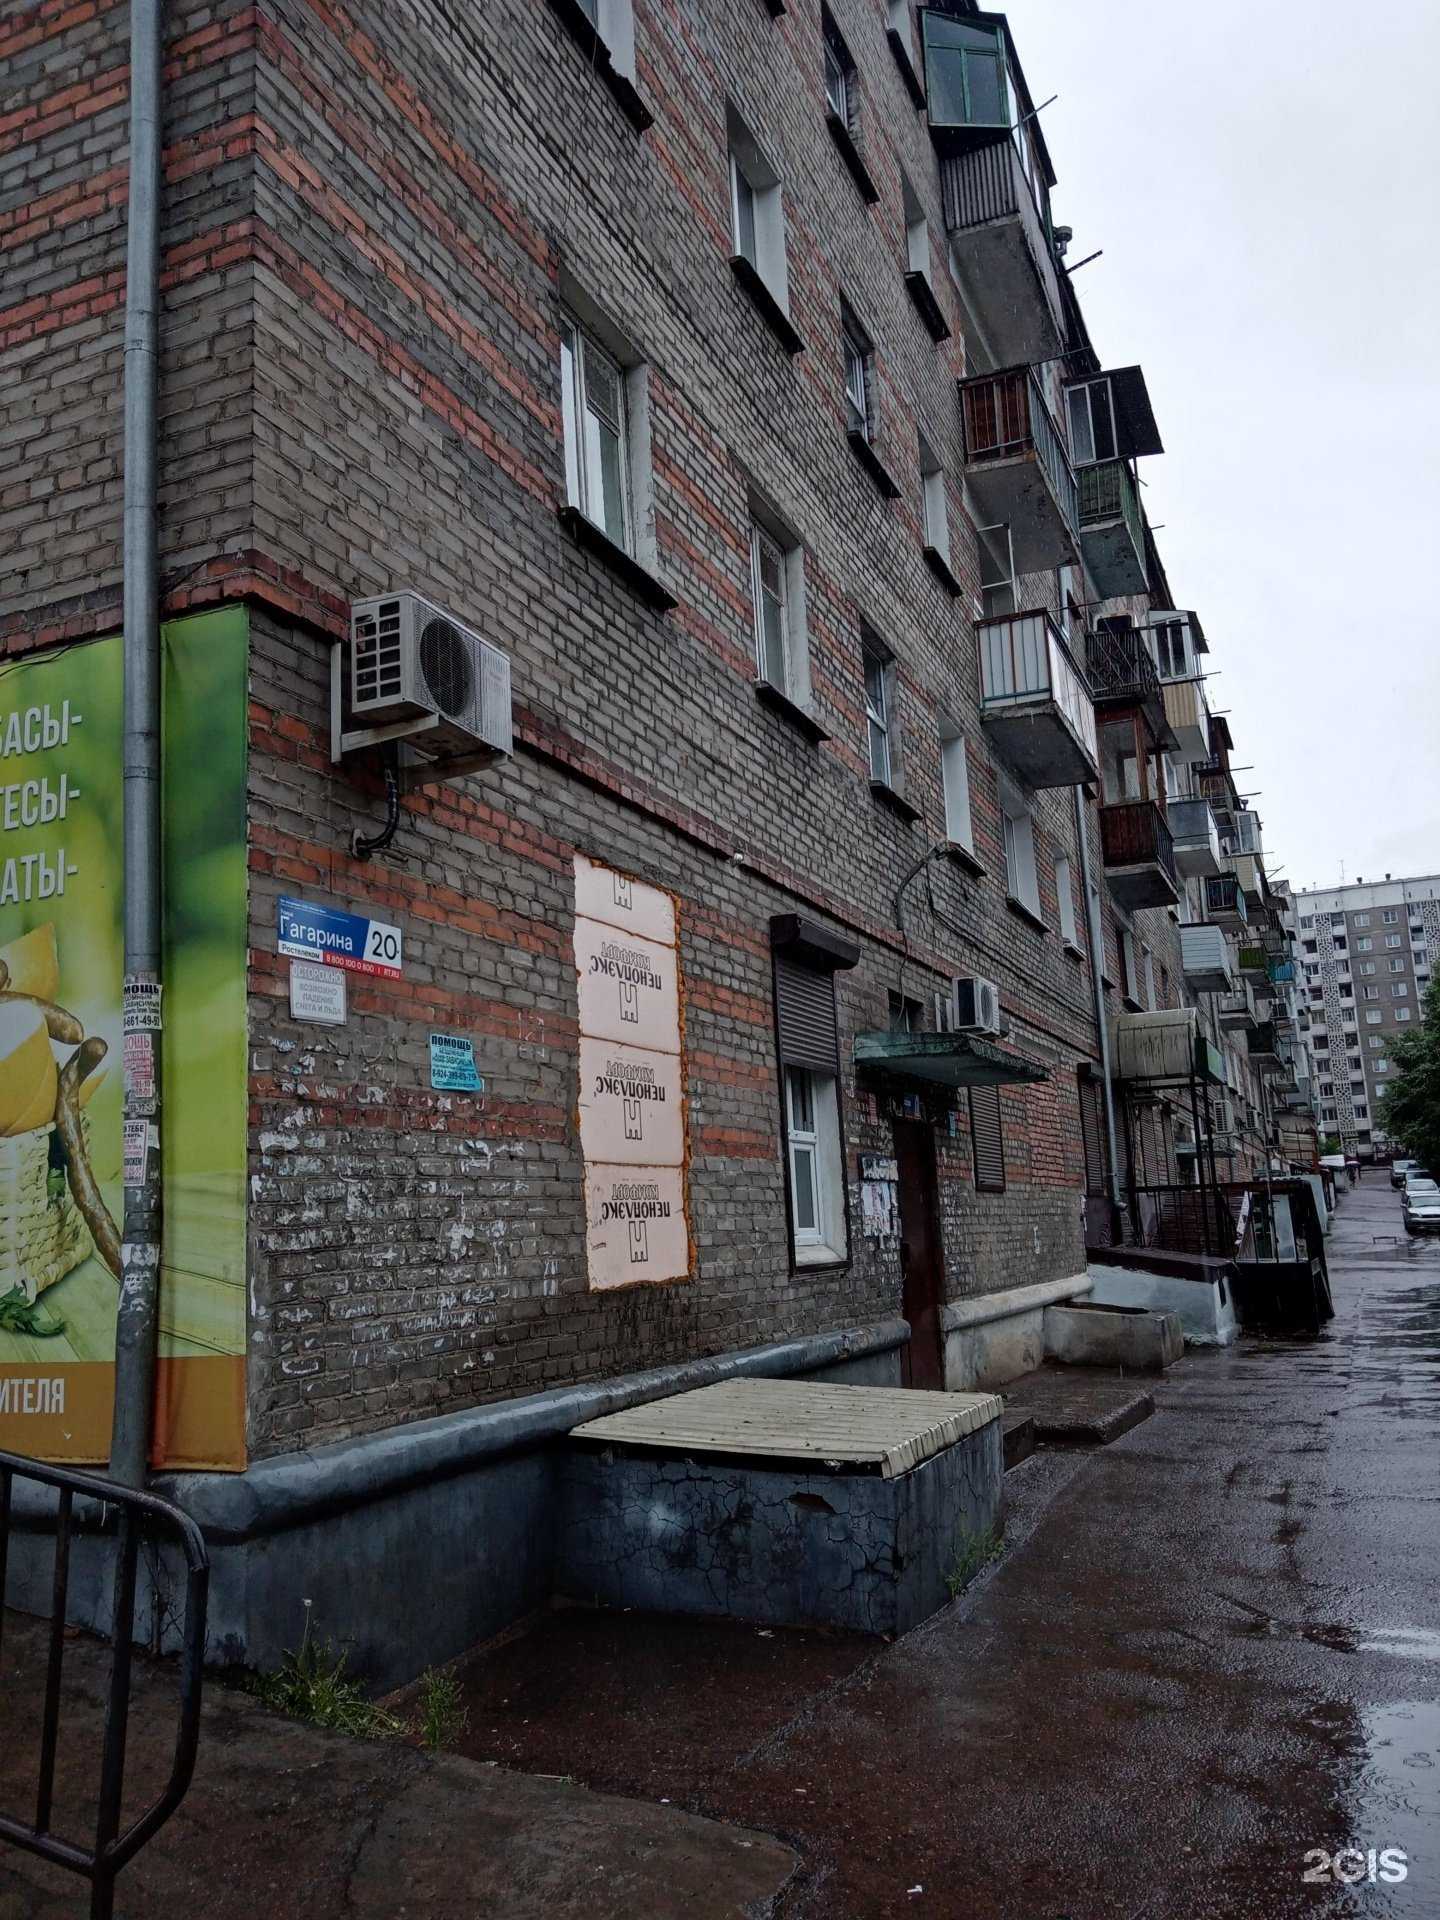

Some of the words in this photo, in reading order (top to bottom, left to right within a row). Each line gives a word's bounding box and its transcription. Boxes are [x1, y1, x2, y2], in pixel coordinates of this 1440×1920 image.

[280, 915, 353, 952] Гагарина
[372, 930, 397, 960] 20
[281, 943, 320, 960] Ростелеком
[600, 942, 651, 971] КОМФОРТ
[590, 955, 662, 990] ПЕНОПЛЭКС
[431, 1035, 471, 1052] ПОМОЩЬ
[605, 1060, 655, 1084] КОМФОРТ
[595, 1076, 666, 1102] ПЕНОПЛЭКС
[611, 1184, 660, 1201] КОМФОРТ
[602, 1202, 671, 1220] ПЕНОПЛЭКС
